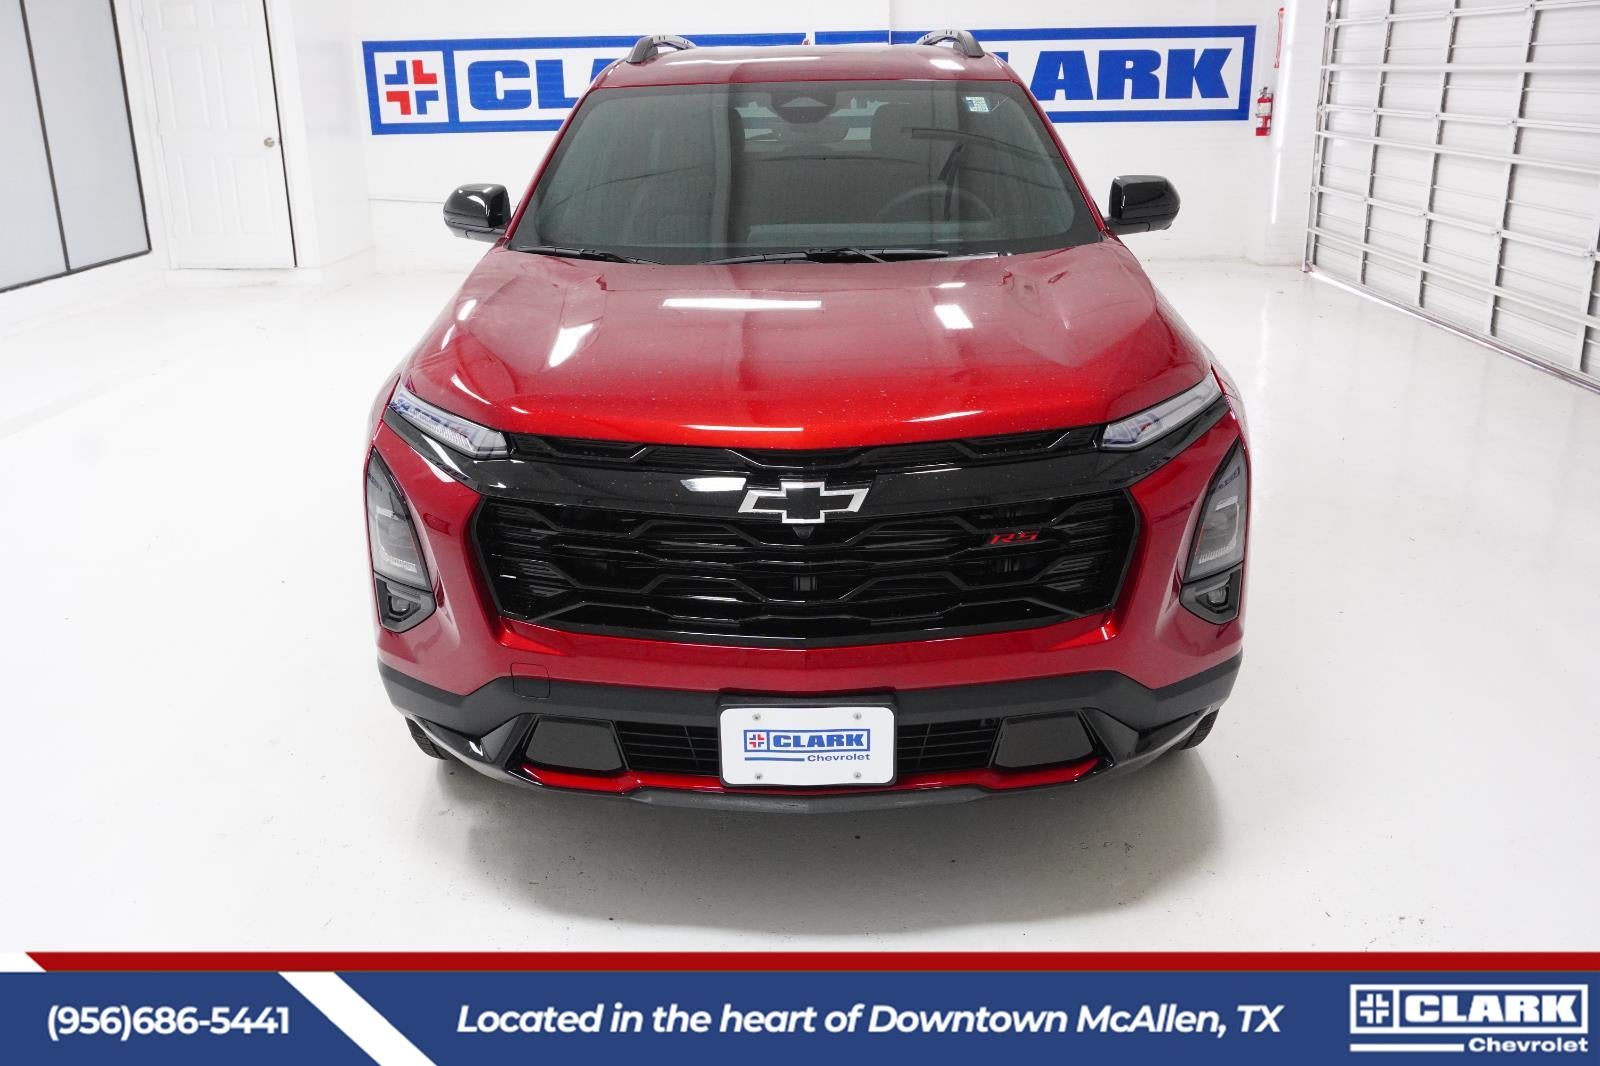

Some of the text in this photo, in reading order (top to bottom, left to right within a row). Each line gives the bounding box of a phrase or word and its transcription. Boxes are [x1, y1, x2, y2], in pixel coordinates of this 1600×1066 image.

[991, 48, 1232, 101] ARK
[989, 531, 1038, 545] RS
[773, 734, 864, 748] CLARK
[807, 753, 871, 762] Chevrolet
